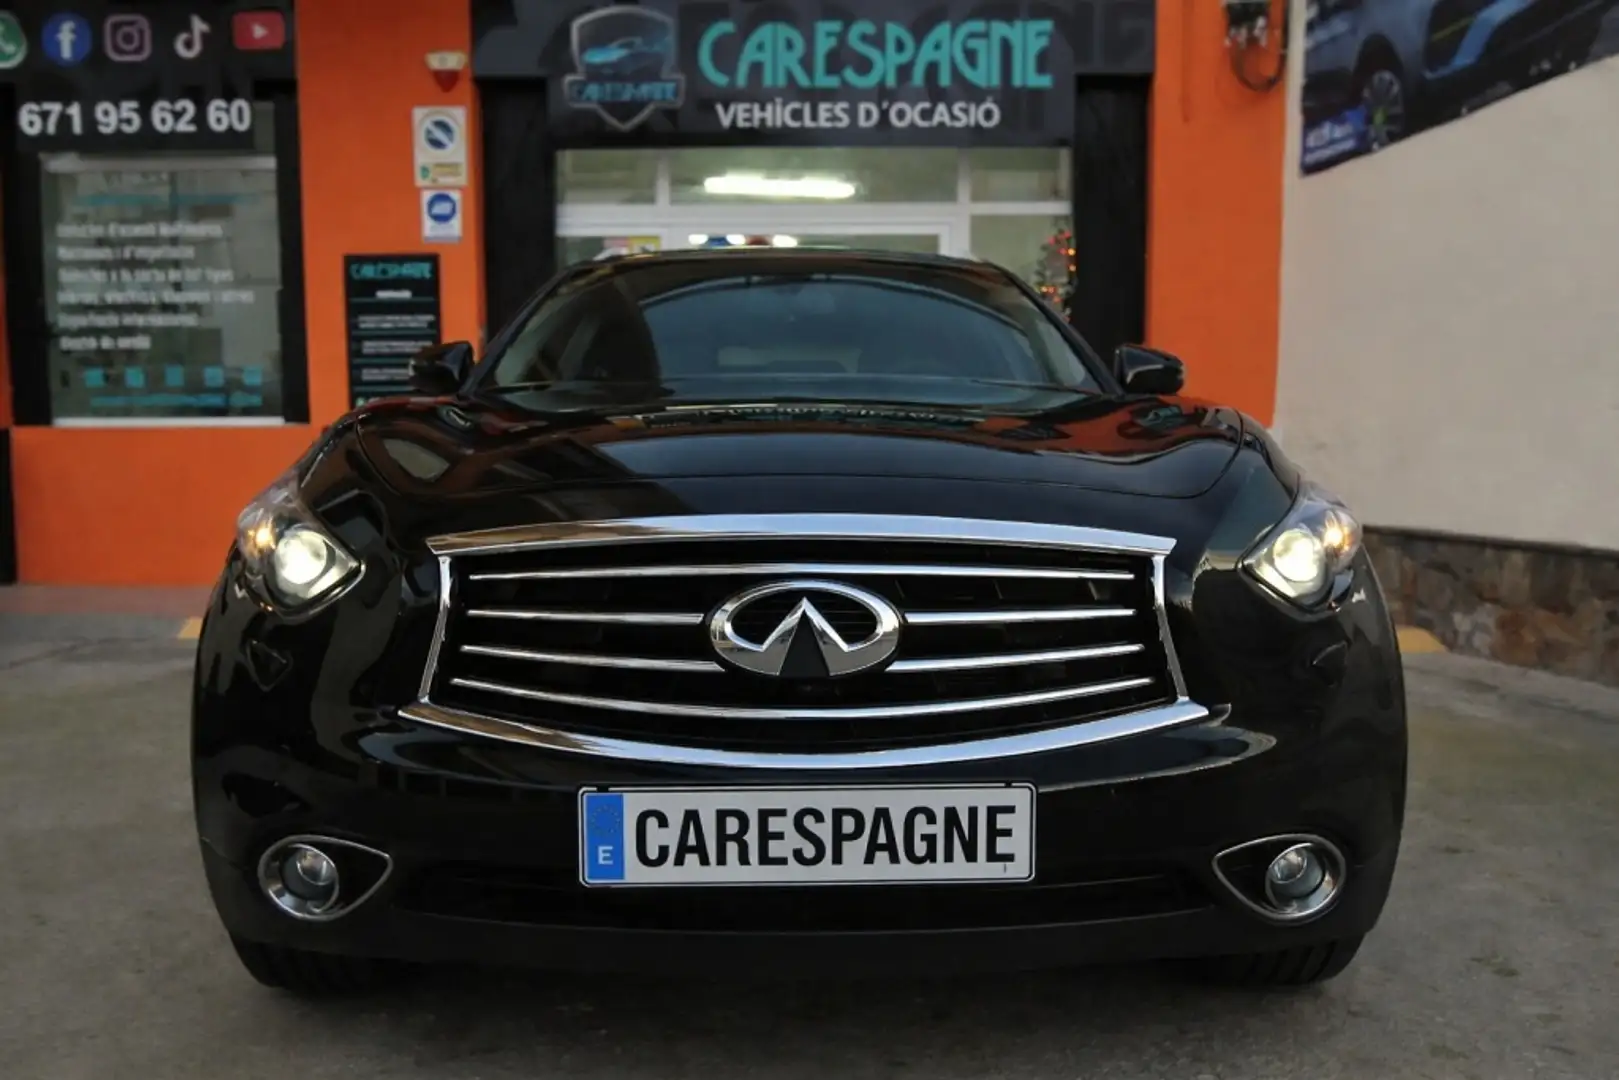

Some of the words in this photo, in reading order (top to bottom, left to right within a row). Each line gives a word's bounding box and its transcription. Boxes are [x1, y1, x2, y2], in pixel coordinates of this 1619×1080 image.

[697, 20, 1054, 88] CARESPAGNE
[18, 101, 82, 136] 671
[95, 100, 141, 134] 95
[151, 99, 196, 133] 62
[207, 98, 251, 132] 60
[597, 845, 614, 865] E
[635, 805, 1017, 868] CARESPAGNE
